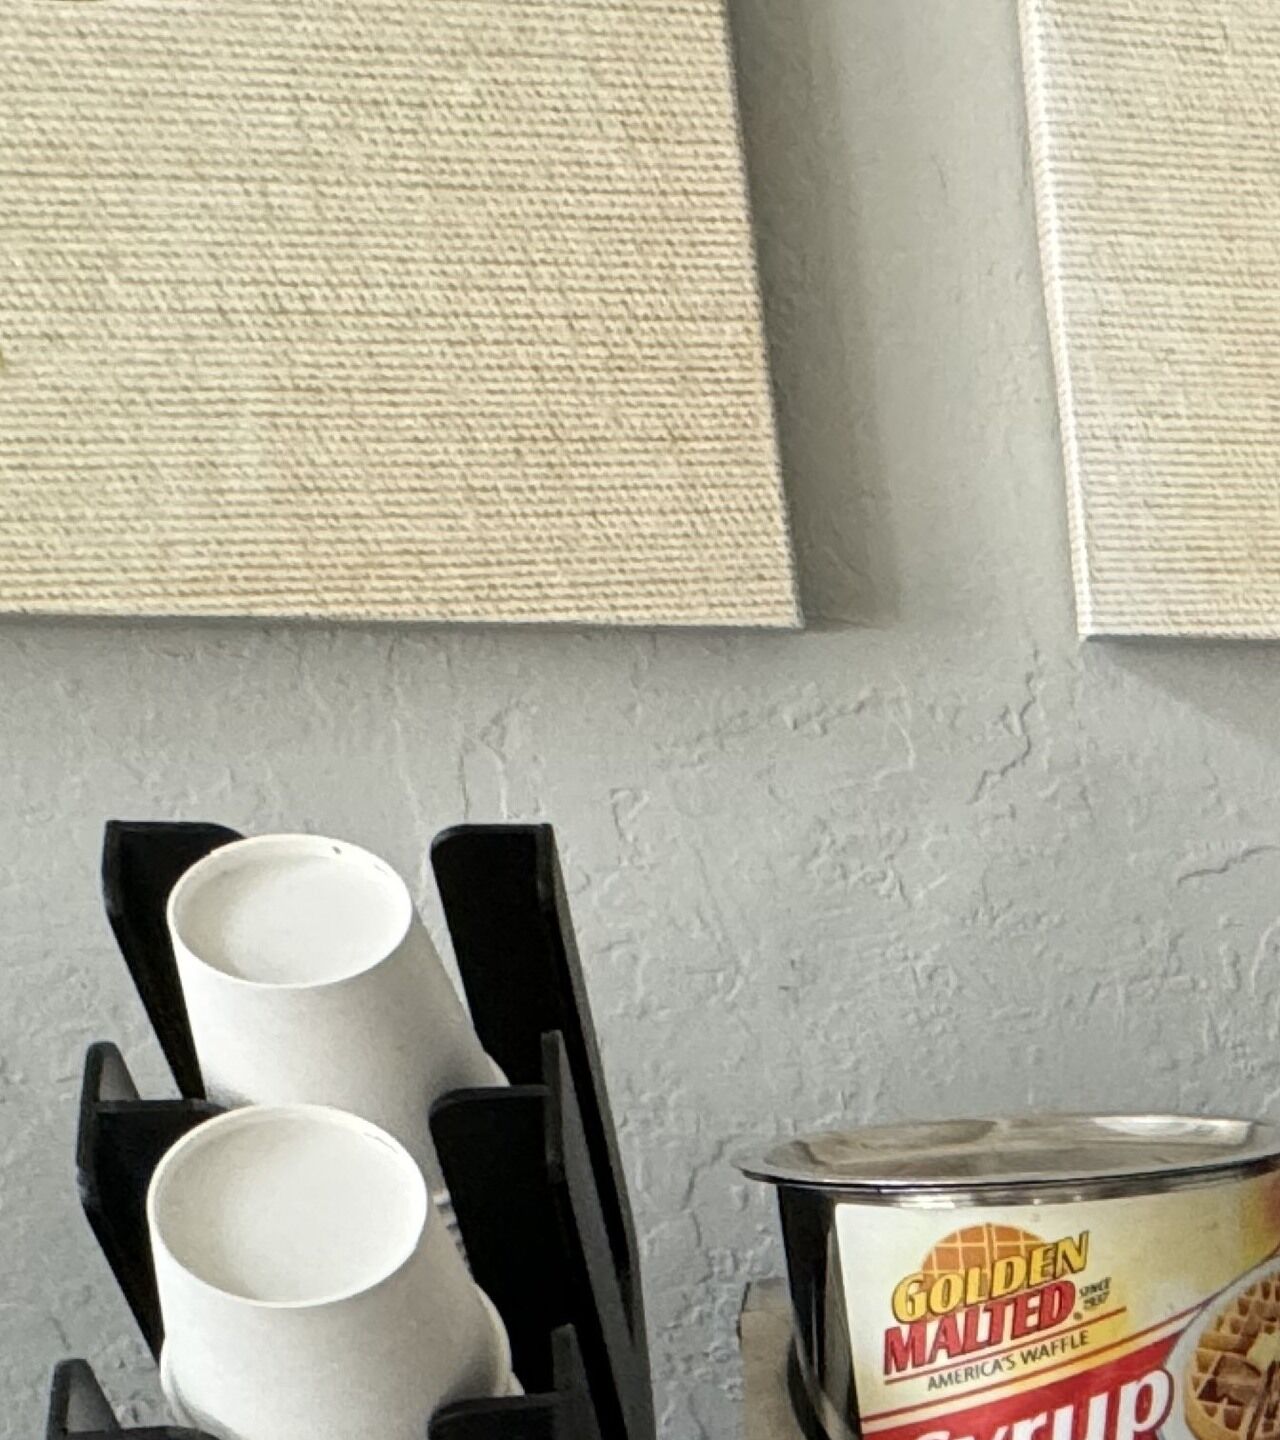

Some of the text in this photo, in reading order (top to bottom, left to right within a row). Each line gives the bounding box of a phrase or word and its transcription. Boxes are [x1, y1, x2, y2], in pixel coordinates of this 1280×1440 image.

[892, 1229, 1090, 1323] GOLDEN
[883, 1279, 1077, 1375] MALTED
[926, 1329, 1090, 1392] AMERICA'S WAFFLE
